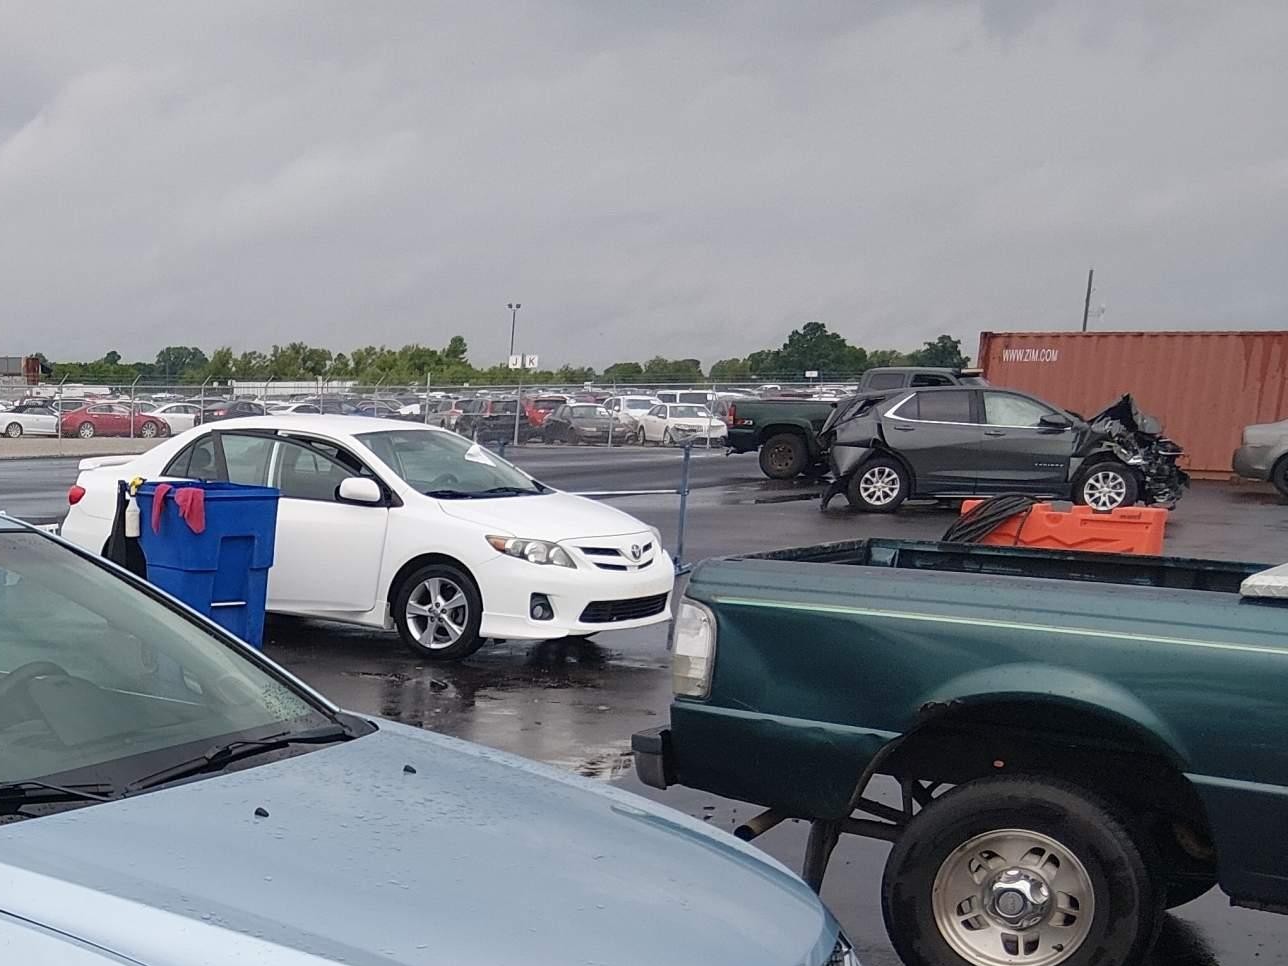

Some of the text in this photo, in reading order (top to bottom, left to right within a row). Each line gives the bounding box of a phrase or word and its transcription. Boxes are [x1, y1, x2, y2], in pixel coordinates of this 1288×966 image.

[1002, 348, 1059, 362] WWW.ZIM.COM
[512, 357, 518, 366] J
[528, 357, 535, 366] K
